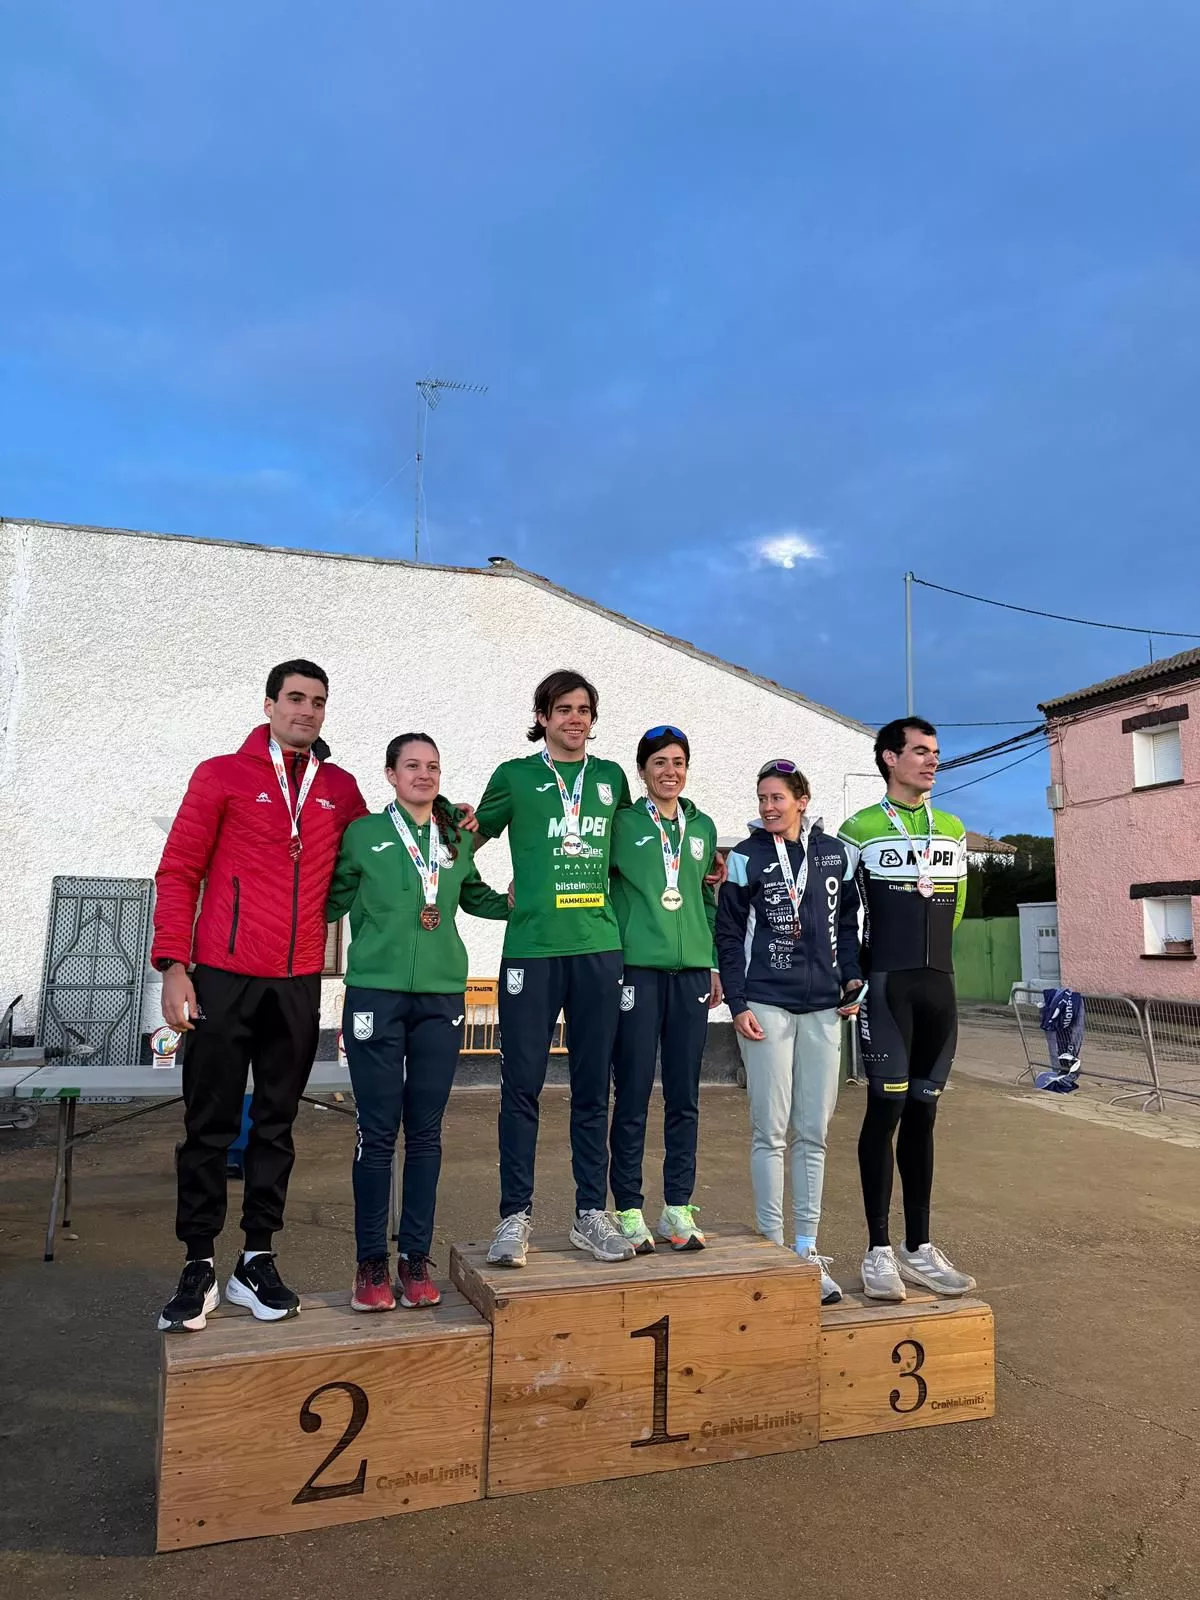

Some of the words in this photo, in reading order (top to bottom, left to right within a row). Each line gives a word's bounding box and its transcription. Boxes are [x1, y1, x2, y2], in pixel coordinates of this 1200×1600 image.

[547, 816, 607, 838] MPEI
[906, 850, 954, 866] MPEI
[630, 1315, 690, 1448] 1
[889, 1339, 927, 1414] 3
[291, 1381, 370, 1505] 2
